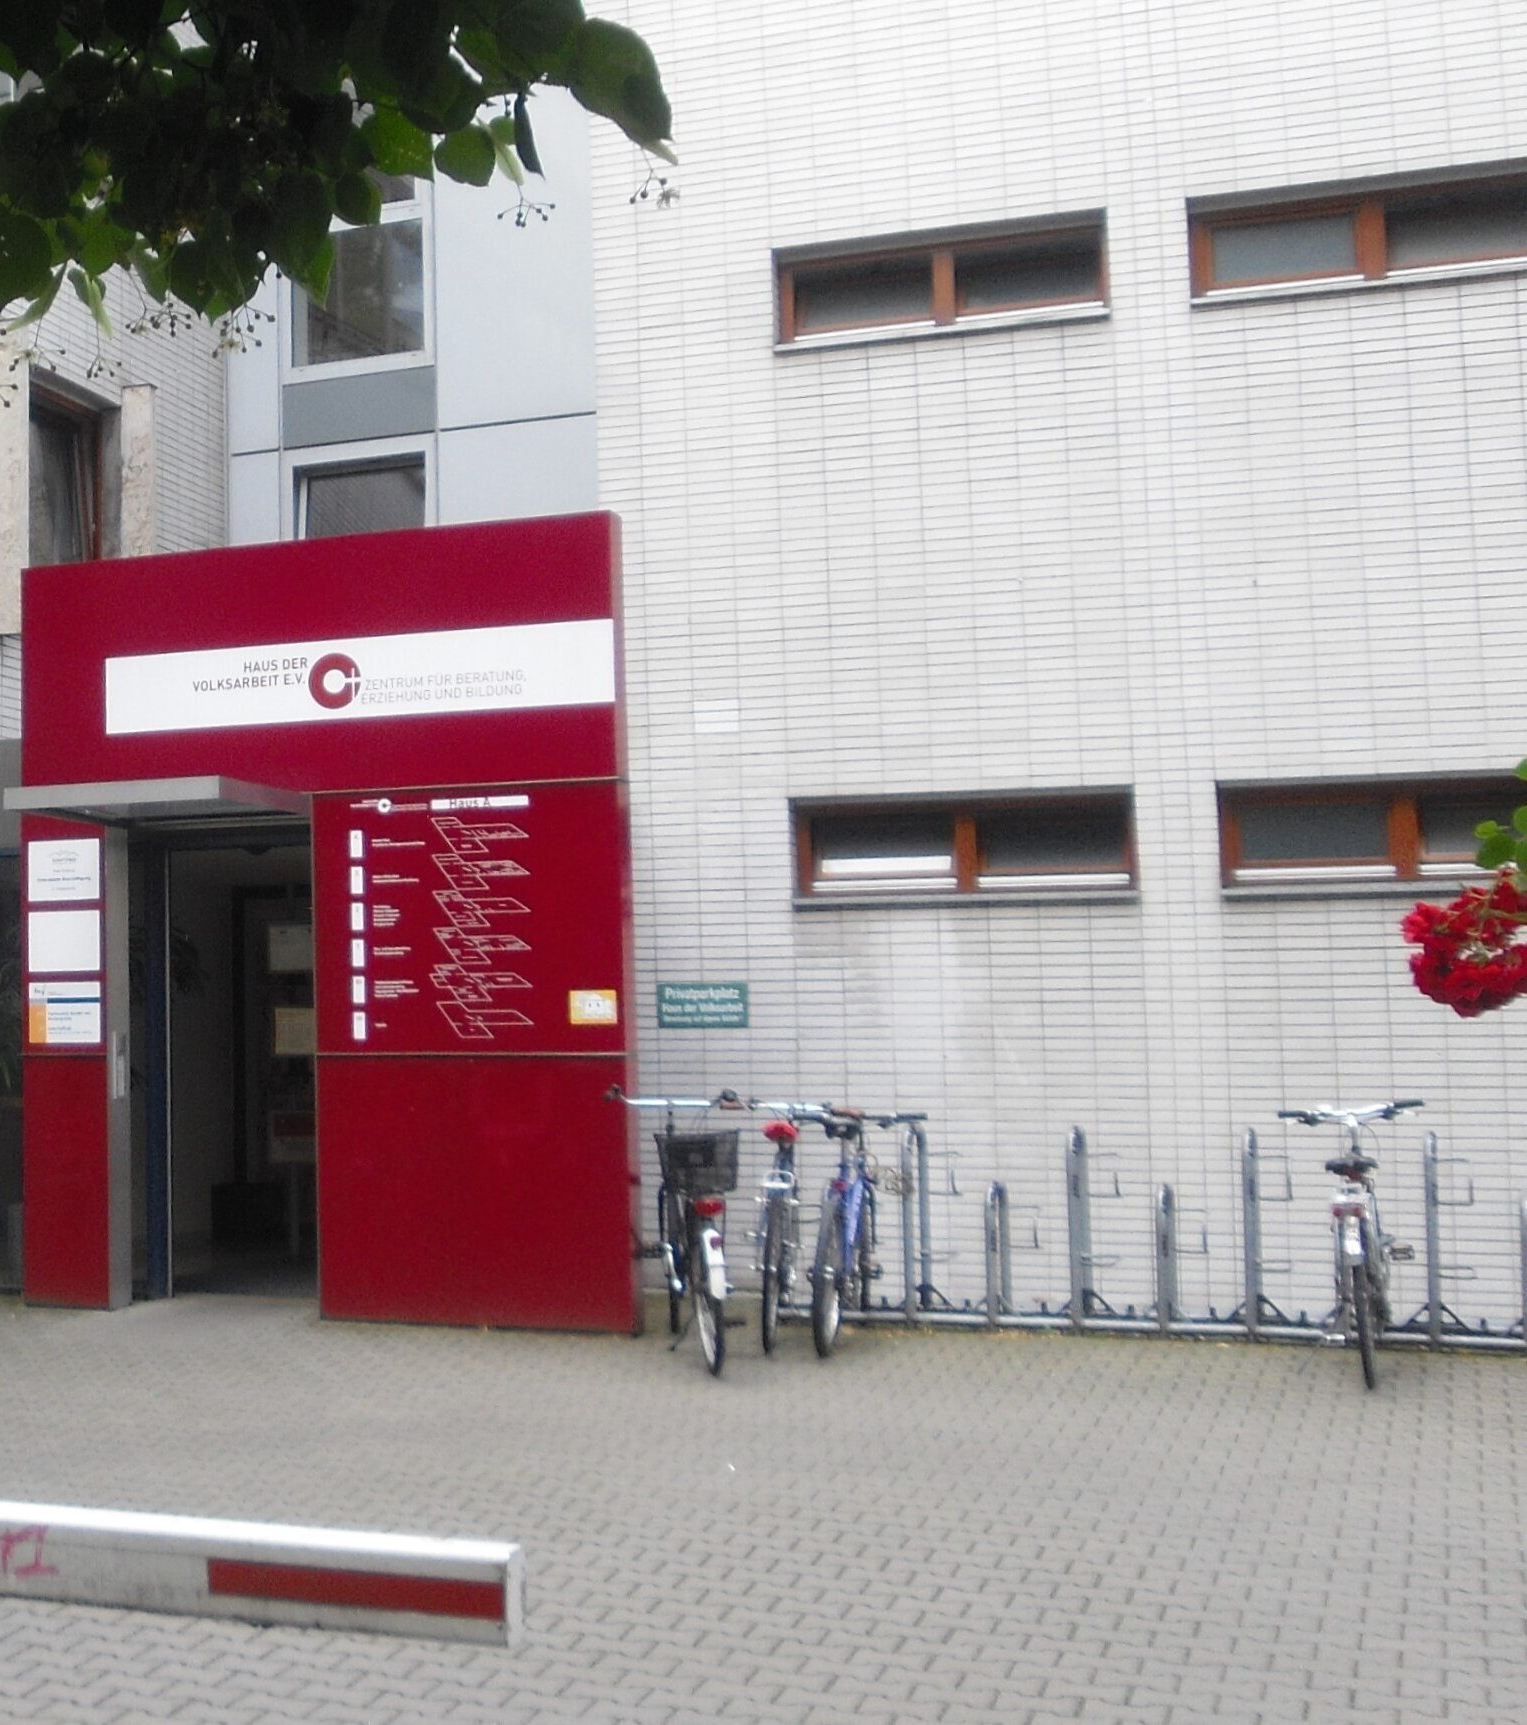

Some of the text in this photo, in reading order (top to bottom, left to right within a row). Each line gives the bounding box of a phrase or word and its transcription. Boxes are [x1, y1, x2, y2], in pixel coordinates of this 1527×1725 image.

[243, 657, 308, 673] HAUS DER
[193, 673, 306, 692] VOLKSARBEIT E.V.
[364, 669, 526, 691] ZENTRUM FÜR BERATUNG,
[361, 683, 522, 705] ERZIEHUNG UND BILDUNG
[449, 797, 492, 808] Haus A
[665, 987, 740, 1001] Privatparkplatz
